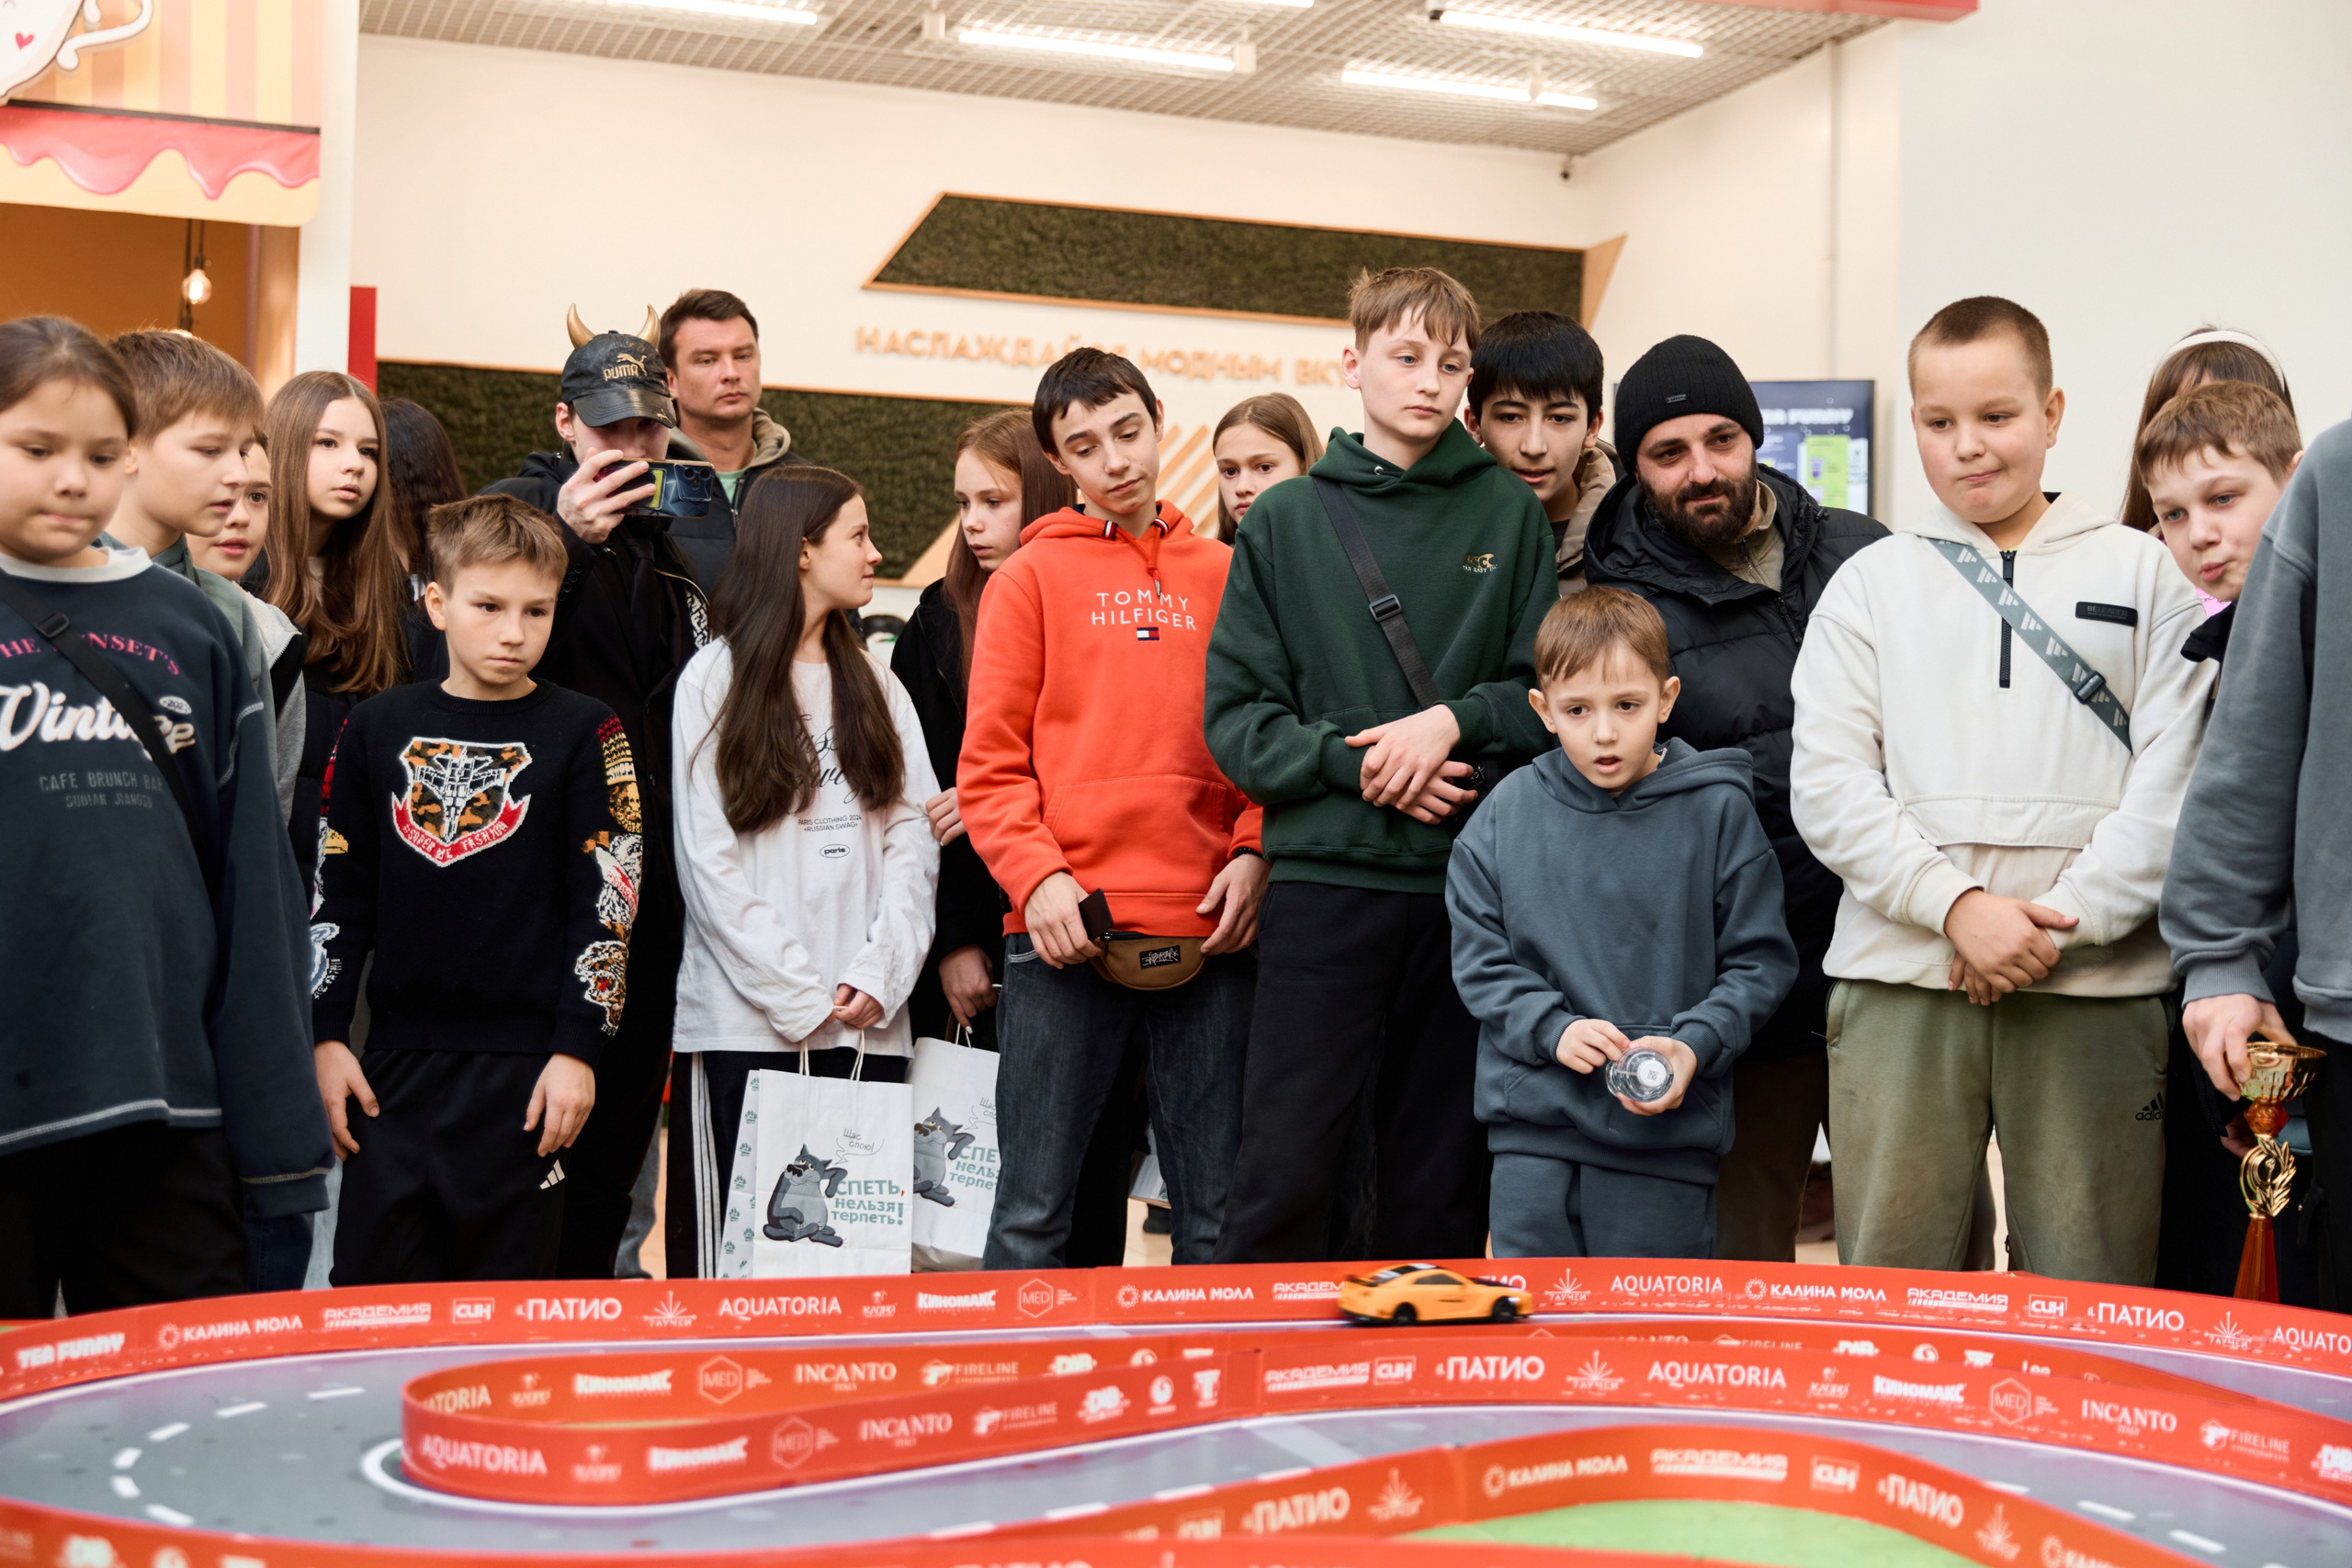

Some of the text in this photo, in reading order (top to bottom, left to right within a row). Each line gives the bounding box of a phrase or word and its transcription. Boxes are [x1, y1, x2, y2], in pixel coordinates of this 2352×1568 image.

[857, 326, 1345, 387] НАСЛАЖДА МОДНЫМ ВКУ
[603, 364, 639, 381] PUMA
[1096, 589, 1189, 612] TOMMY
[1091, 607, 1197, 631] HILFIGER
[0, 631, 180, 676] HE NSET'S
[0, 681, 196, 761] Vinte
[40, 773, 79, 792] CAFE
[87, 772, 138, 788] BRUNCH
[814, 816, 848, 825] CLOTHING
[824, 847, 846, 855] paris
[982, 1109, 997, 1120] спо
[843, 1127, 862, 1142] Щас
[959, 1145, 999, 1163] СПЕ
[955, 1159, 1001, 1179] нель
[949, 1171, 999, 1191] терпе
[1142, 1287, 1254, 1302] КАЛИНА МОЛЛ
[1272, 1280, 1348, 1292] АКАДЕМ
[1611, 1275, 1723, 1296] AQUATORIA
[1770, 1284, 1886, 1301] КАЛИНА МОЛЛ
[1907, 1288, 2008, 1304] АКАДЕМИЯ
[526, 1297, 622, 1321] ПАТИО
[719, 1296, 842, 1321] AQUATORIA
[918, 1290, 997, 1309] КИНОМАКС
[1023, 1292, 1050, 1304] MED
[324, 1302, 432, 1319] АКАДЕМИЯ
[2098, 1302, 2185, 1331] ПАТИО
[183, 1315, 303, 1342] КАЛИНА МОЛЛ
[2273, 1325, 2352, 1354] AQUATO
[704, 1371, 739, 1388] MED
[796, 1361, 897, 1382] INCANTO
[955, 1361, 1020, 1376] FIRELINE
[1264, 1361, 1371, 1382] АКАДЕМИЯ
[1446, 1356, 1545, 1381] ПАТИО
[1647, 1360, 1787, 1388] AQUATORIA
[575, 1369, 673, 1395] КИНОМАКС
[1873, 1374, 1965, 1403] КИНОМАКС
[423, 1384, 492, 1414] ATORIA
[1995, 1392, 2027, 1410] MED
[860, 1412, 953, 1441] INCANTO
[2081, 1399, 2177, 1433] INCANTO
[2231, 1430, 2290, 1453] FIRELINE
[422, 1434, 548, 1476] AQUATORIA
[1650, 1448, 1789, 1470] АКАДЕМИЯ
[1508, 1455, 1628, 1488] КАЛИНА МОЛЛ
[1251, 1486, 1350, 1533] ПАТИО
[1886, 1473, 1964, 1529] ПАТИО
